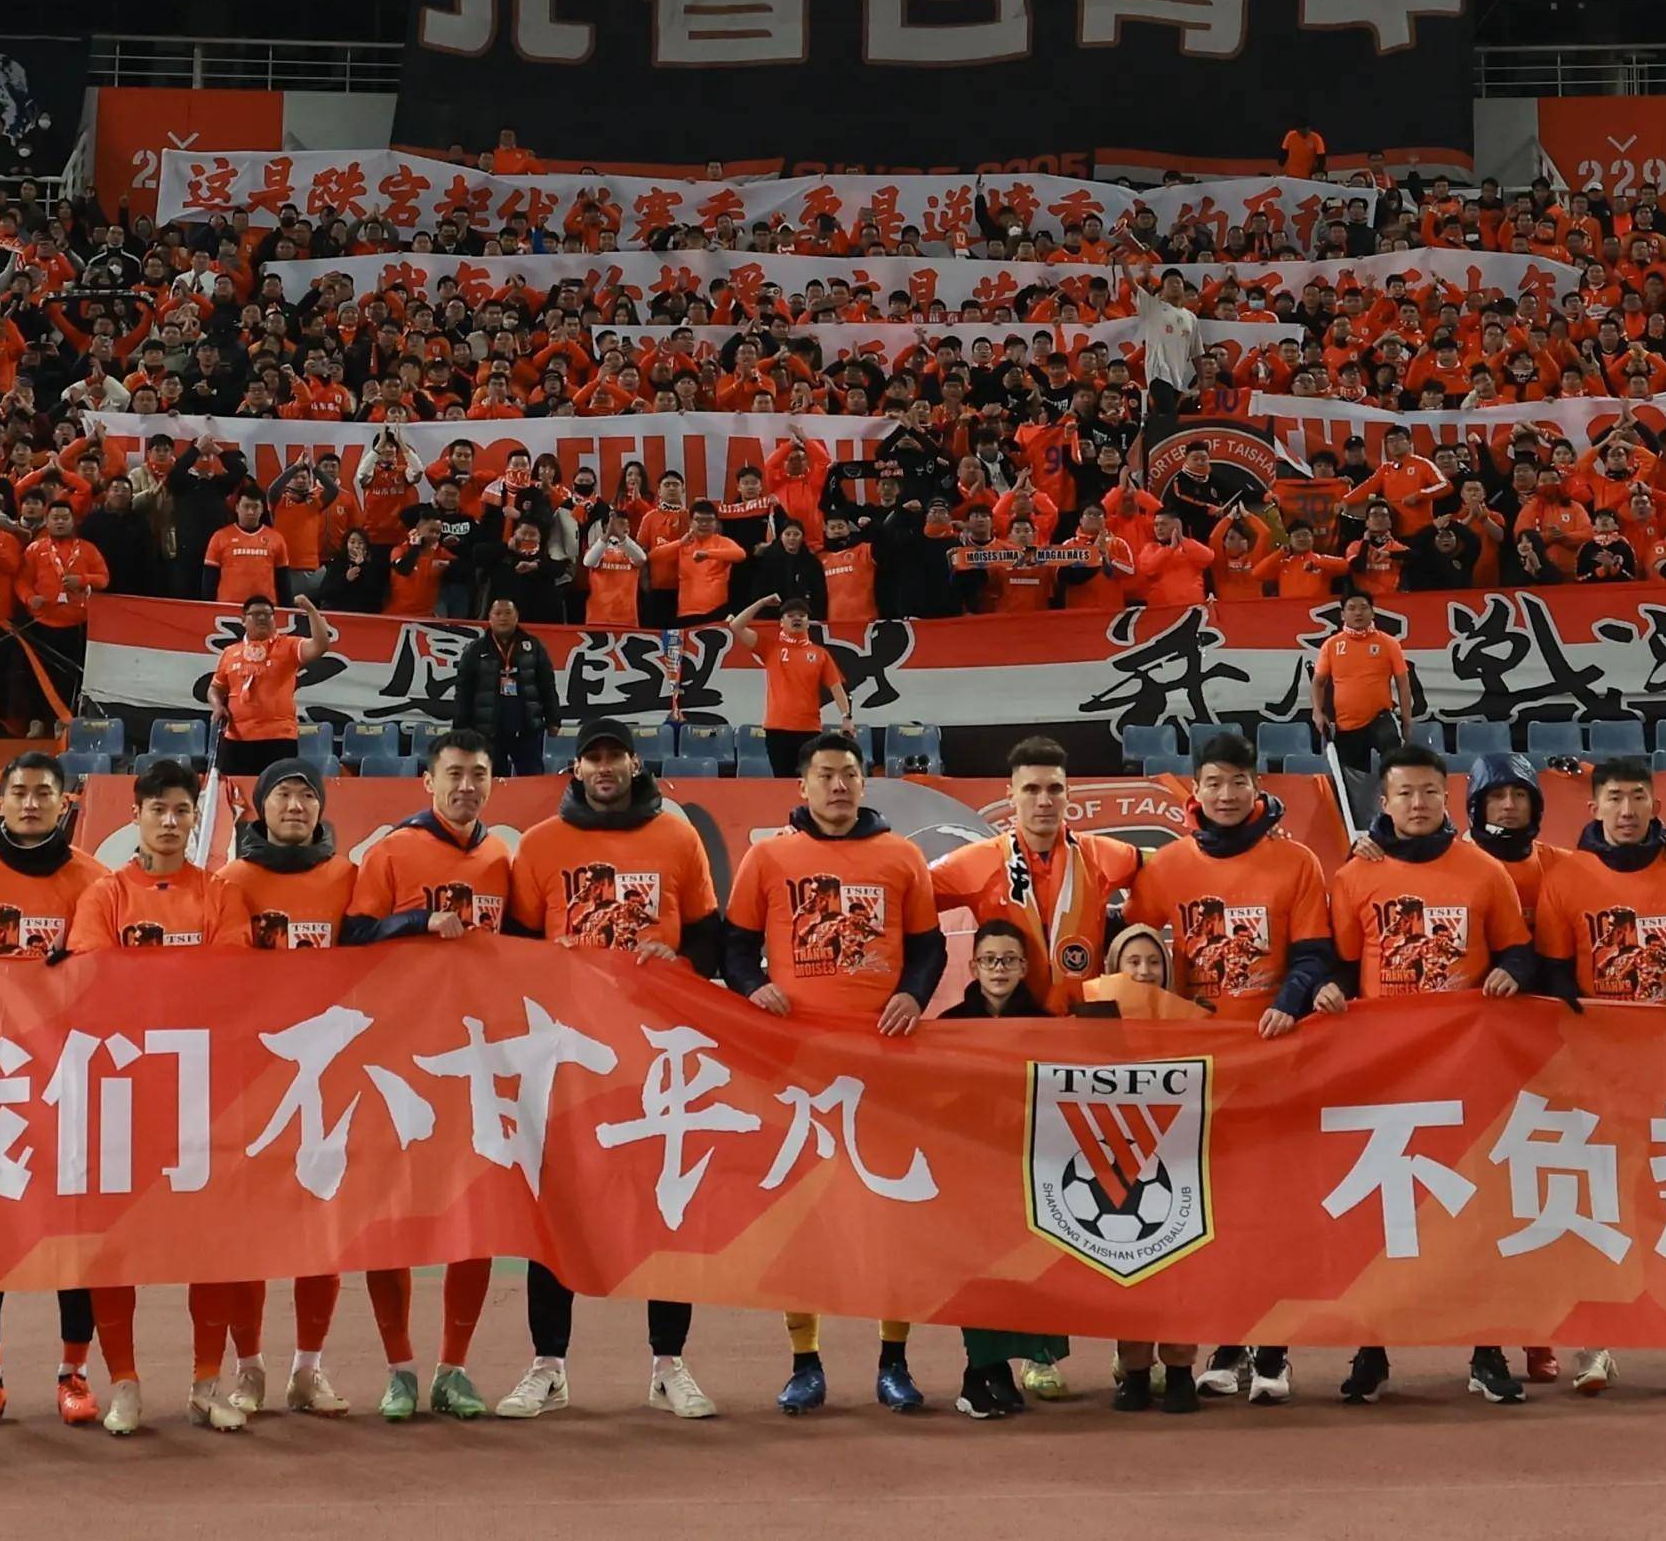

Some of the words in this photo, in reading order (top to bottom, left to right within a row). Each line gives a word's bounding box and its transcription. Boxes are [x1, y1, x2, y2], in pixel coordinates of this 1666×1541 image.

[999, 549, 1019, 561] LIMA
[1335, 641, 1347, 655] 12
[1115, 796, 1185, 828] TAIS
[618, 873, 656, 883] TSFC
[844, 886, 882, 896] TSFC
[1227, 908, 1265, 918] TSFC
[1427, 907, 1465, 917] TSFC
[22, 918, 62, 928] TSFC
[291, 923, 330, 933] TSFC
[794, 947, 835, 962] THANKS
[1052, 1068, 1190, 1099] TSFC
[1041, 1182, 1081, 1246] SHANDONG
[1081, 1238, 1136, 1264] TAISHAN
[1135, 1215, 1183, 1263] FOOTBALL
[1174, 1186, 1193, 1223] CLUB
